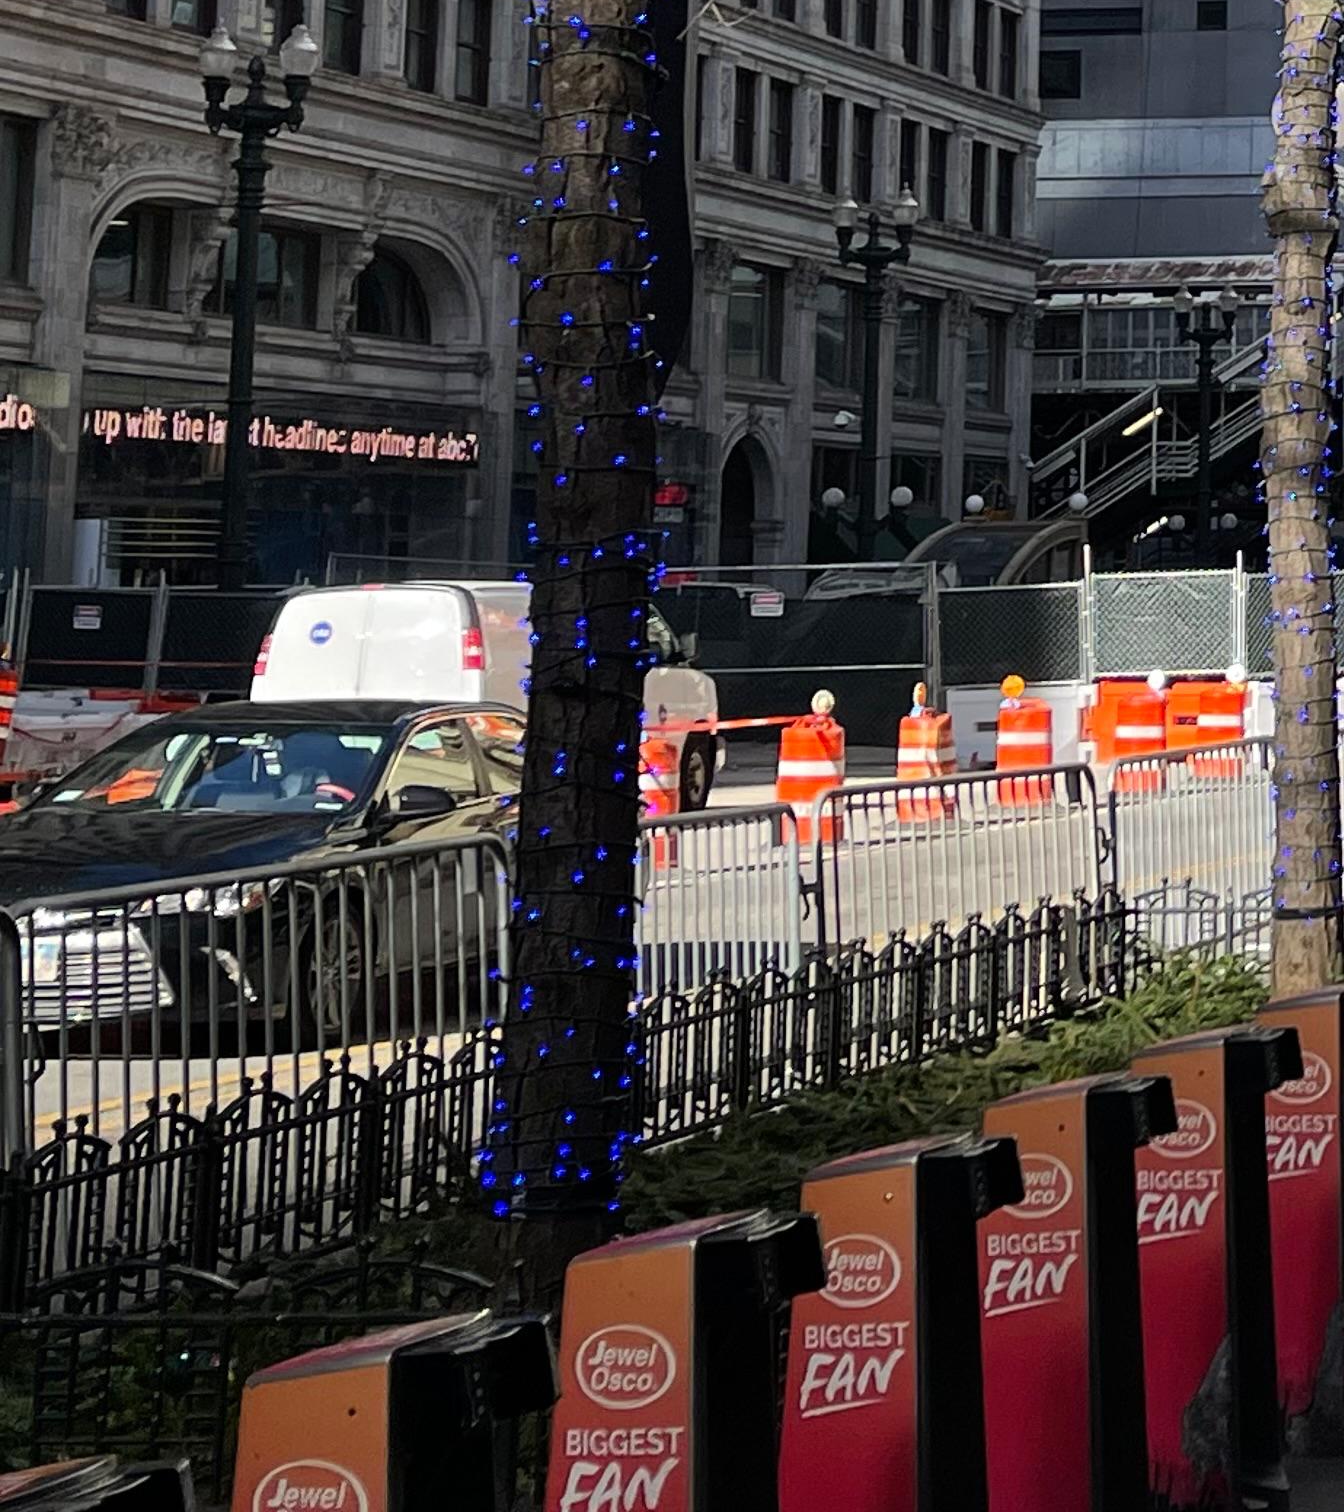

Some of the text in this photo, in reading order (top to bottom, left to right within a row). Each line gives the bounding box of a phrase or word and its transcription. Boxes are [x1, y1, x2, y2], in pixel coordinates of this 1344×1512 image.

[94, 409, 121, 445] up
[173, 408, 204, 443] the
[351, 426, 416, 462] anytime
[418, 431, 436, 460] at
[1023, 1167, 1059, 1186] wel
[1136, 1168, 1224, 1191] BIGGEST
[1136, 1190, 1220, 1234] FAN
[986, 1229, 1082, 1257] BIGGEST
[826, 1270, 882, 1293] Osco
[983, 1253, 1079, 1311] FAN
[804, 1320, 911, 1350] BIGGEST
[588, 1340, 658, 1367] Jewel
[590, 1366, 654, 1392] Osco
[799, 1348, 906, 1411] FAN
[565, 1425, 686, 1457] BIGGEST
[266, 1478, 348, 1509] Jewel
[559, 1456, 681, 1512] FAN
